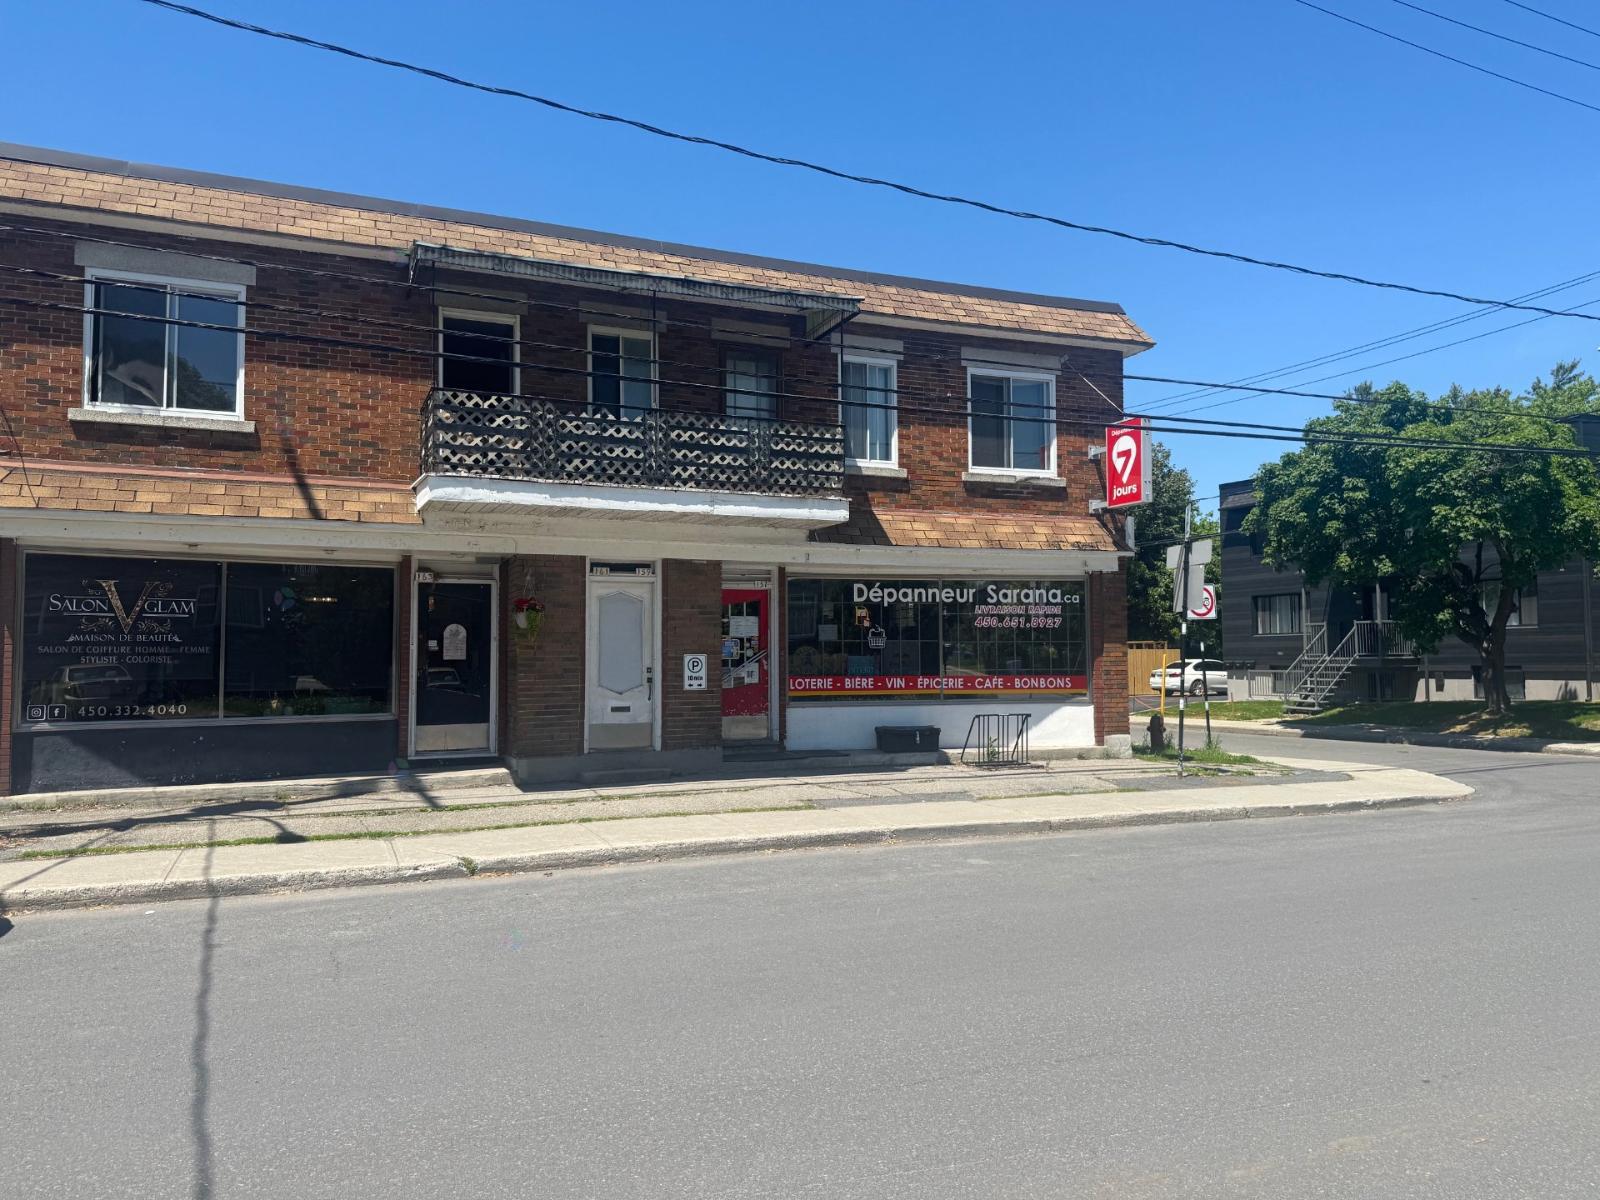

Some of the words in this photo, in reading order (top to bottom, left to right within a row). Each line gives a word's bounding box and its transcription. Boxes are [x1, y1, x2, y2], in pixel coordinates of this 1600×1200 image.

[1112, 484, 1137, 500] jours
[853, 582, 976, 607] Dépanneur
[144, 600, 195, 614] GLAM
[975, 604, 1025, 614] LIVRAISON
[1027, 604, 1062, 614] RAPIDE
[975, 616, 1062, 628] 450.651.8927
[74, 634, 115, 642] MAISON
[119, 634, 133, 642] DE
[136, 632, 173, 642] BEAUTÉ
[38, 645, 68, 654] SALON
[71, 645, 83, 654] DE
[86, 645, 130, 654] COIFFURE
[135, 645, 169, 654] HOMME
[80, 655, 118, 664] STYLISTE
[126, 655, 173, 664] COLORISTE
[789, 678, 833, 690] LOTERIE
[885, 678, 905, 689] VIN
[917, 676, 964, 689] ÉPICERIE
[1014, 678, 1072, 689] BONBONS
[78, 704, 187, 717] 450.332.4040
